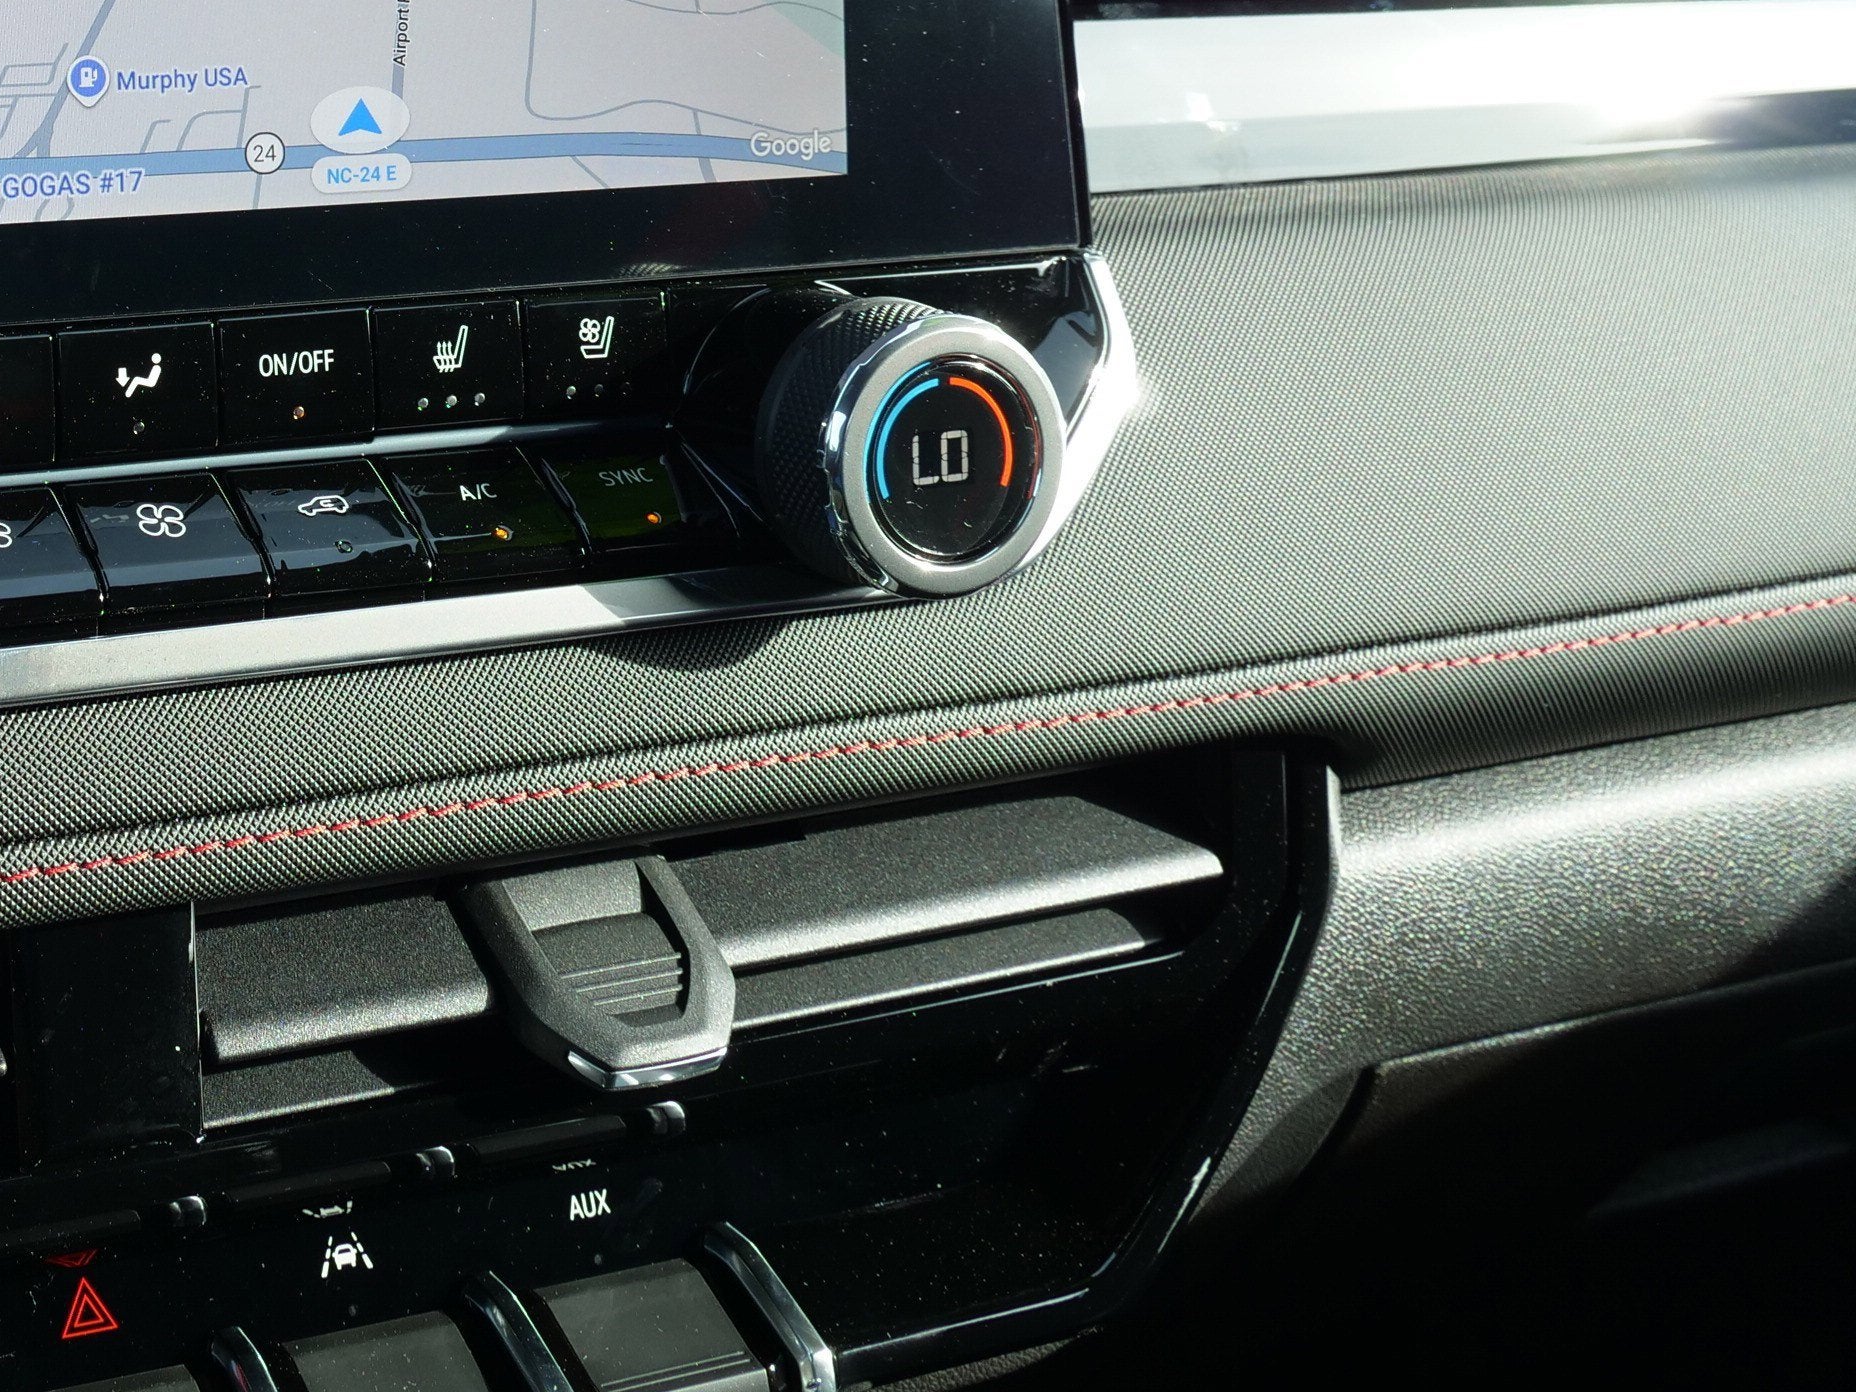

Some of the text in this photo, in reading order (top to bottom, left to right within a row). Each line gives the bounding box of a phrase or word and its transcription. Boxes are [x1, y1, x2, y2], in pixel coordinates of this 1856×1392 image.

[392, 8, 411, 67] Airport
[116, 66, 249, 94] Murphy USA
[252, 144, 277, 163] 24
[750, 128, 832, 162] Google
[2, 170, 144, 199] GOGAS #17
[326, 164, 398, 185] NC-24 E
[258, 348, 335, 379] ON/OFF
[911, 428, 970, 488] LO
[598, 467, 654, 487] SYNC
[459, 482, 498, 502] A/C
[569, 1188, 611, 1221] AUX
